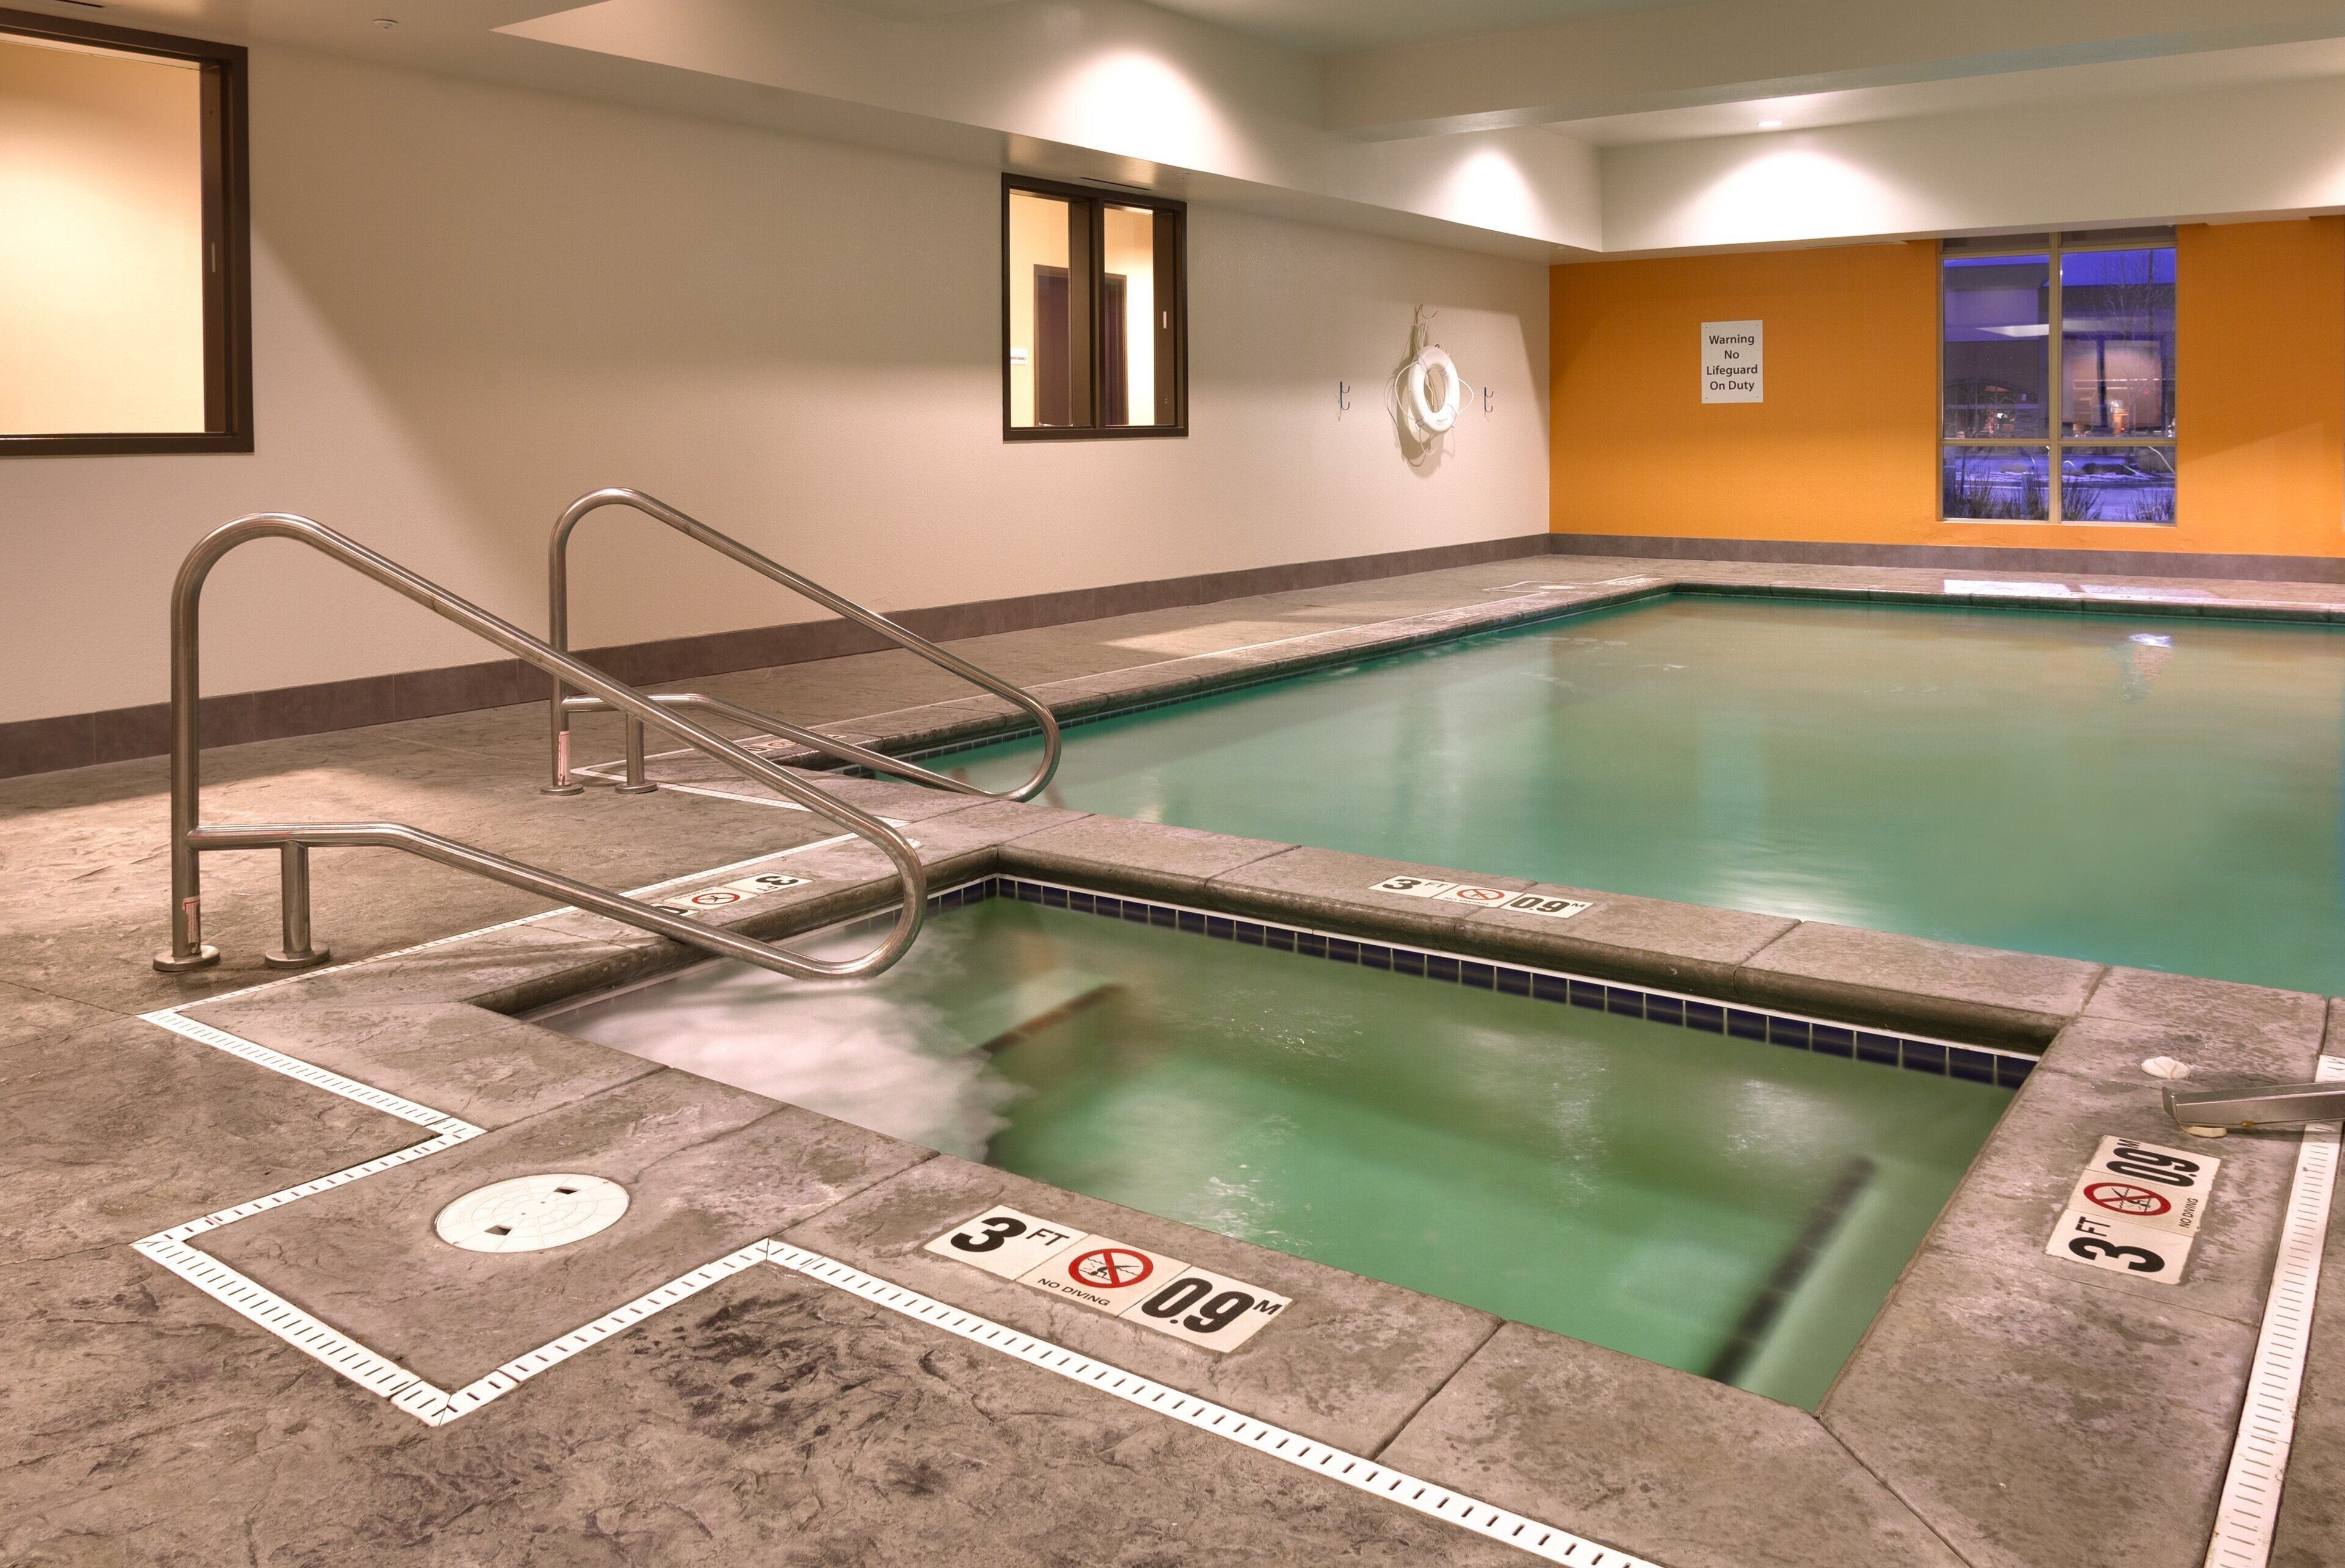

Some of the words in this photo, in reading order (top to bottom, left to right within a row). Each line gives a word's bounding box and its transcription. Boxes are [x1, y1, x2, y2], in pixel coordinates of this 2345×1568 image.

[1709, 334, 1754, 346] Warning
[1724, 350, 1740, 359] No
[1706, 364, 1758, 377] Lifeguard
[1709, 381, 1725, 391] On
[1728, 380, 1755, 392] Duty
[755, 876, 799, 885] 3
[1382, 879, 1422, 890] 3
[1510, 896, 1570, 913] 0.9
[2106, 1147, 2200, 1188] 0.9
[2182, 1197, 2198, 1218] DIVING
[2074, 1216, 2111, 1237] FT
[2178, 1218, 2192, 1229] NO
[950, 1216, 1027, 1252] 3
[1025, 1227, 1071, 1247] FT
[2068, 1236, 2165, 1272] 3
[1037, 1278, 1060, 1288] NO
[1061, 1286, 1110, 1306] DIVING
[1141, 1277, 1255, 1334] 0.9
[1252, 1299, 1283, 1316] M
